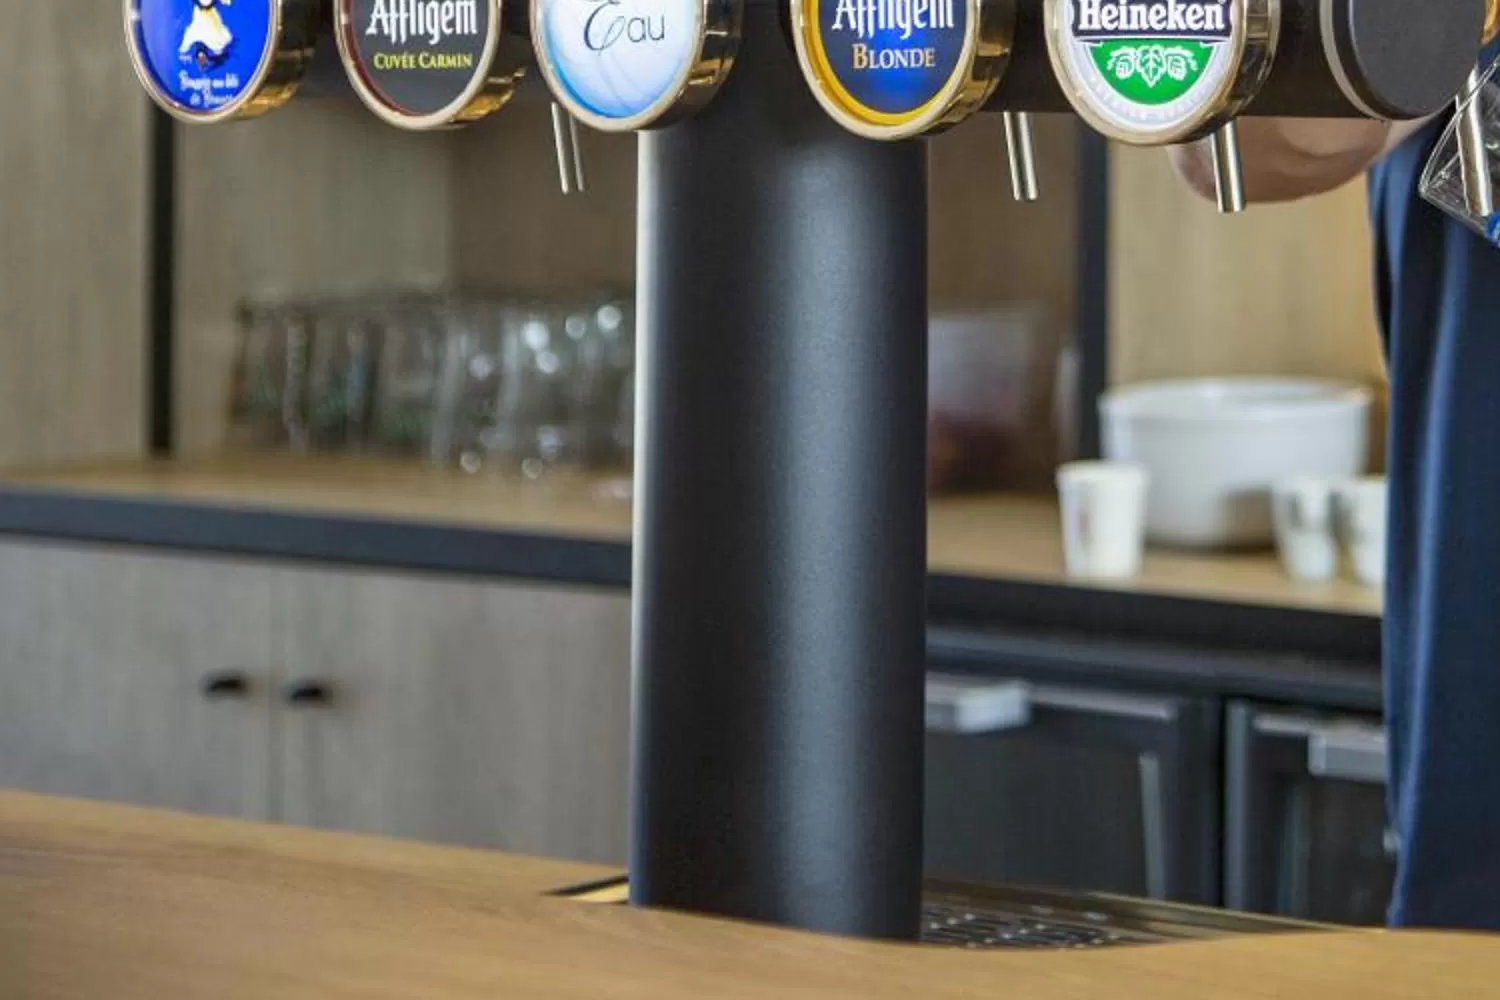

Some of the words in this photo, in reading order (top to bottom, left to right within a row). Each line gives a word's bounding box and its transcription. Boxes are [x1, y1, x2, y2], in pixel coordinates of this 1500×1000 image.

[374, 50, 417, 69] CUVÉE
[418, 51, 473, 69] CARMIN
[852, 43, 936, 69] BLONDE
